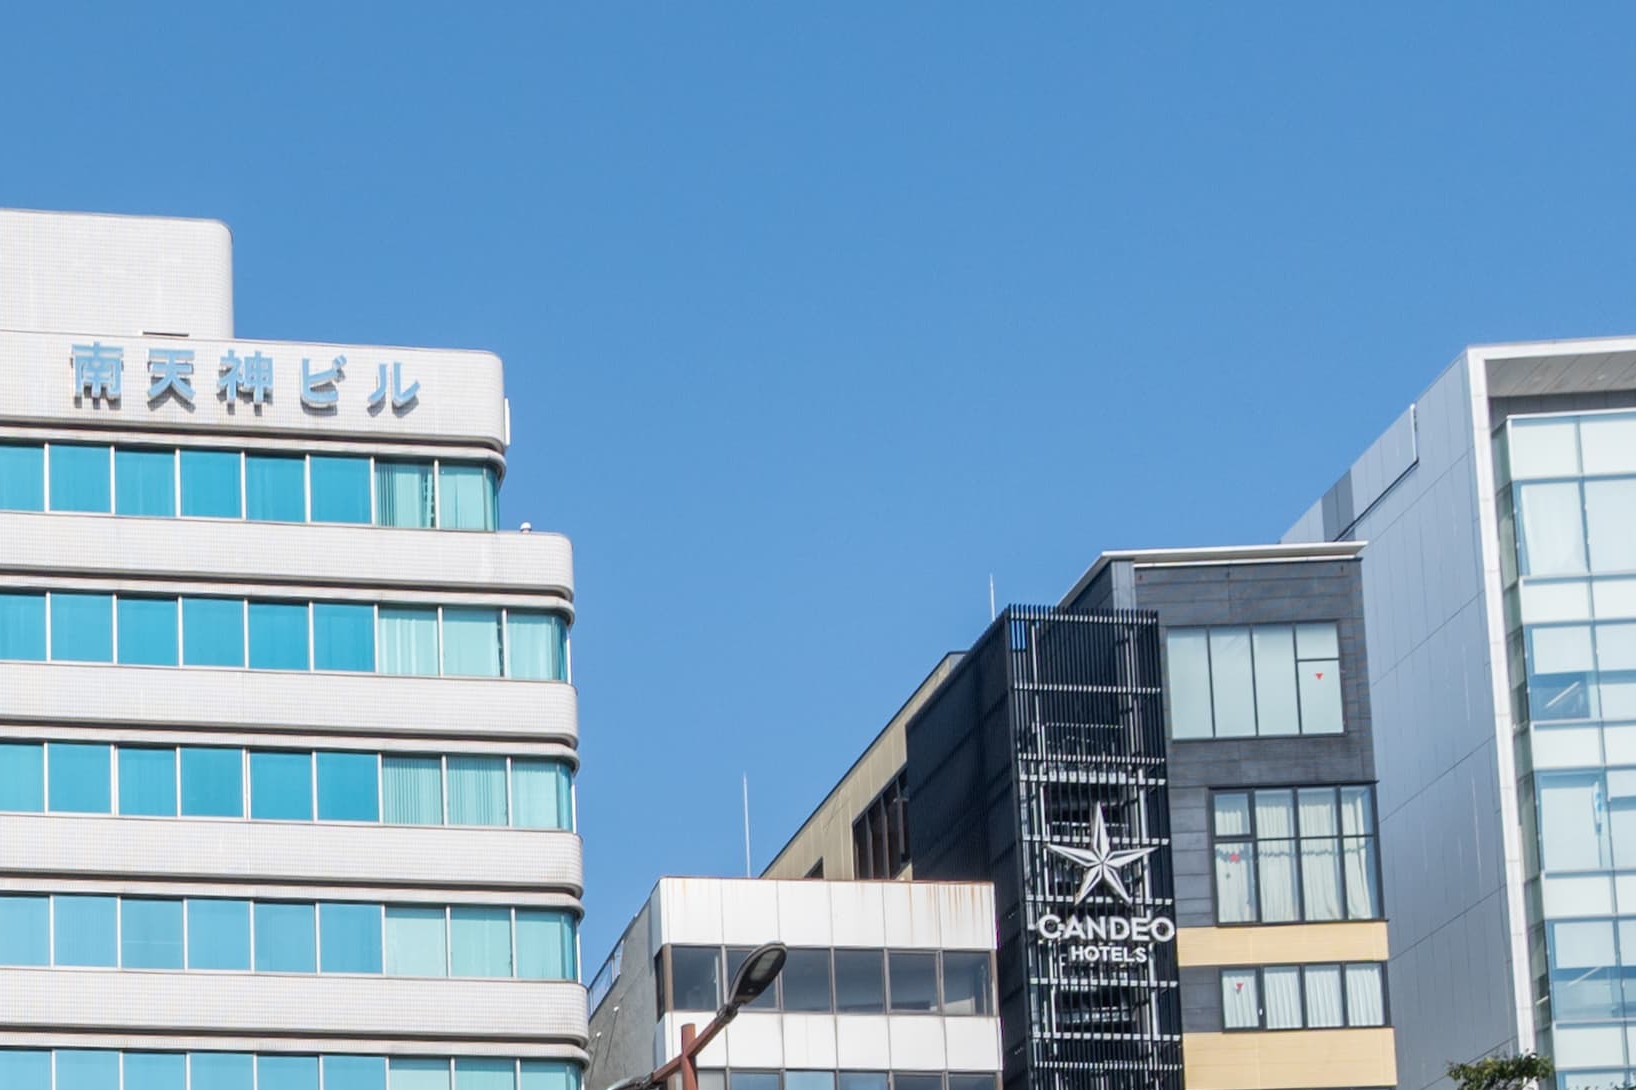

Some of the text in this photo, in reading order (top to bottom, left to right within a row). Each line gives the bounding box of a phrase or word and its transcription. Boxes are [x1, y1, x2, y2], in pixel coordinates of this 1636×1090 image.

[71, 341, 421, 408] 南天神ビル
[1038, 913, 1175, 942] CANDEO
[1071, 945, 1147, 963] HOTELS
